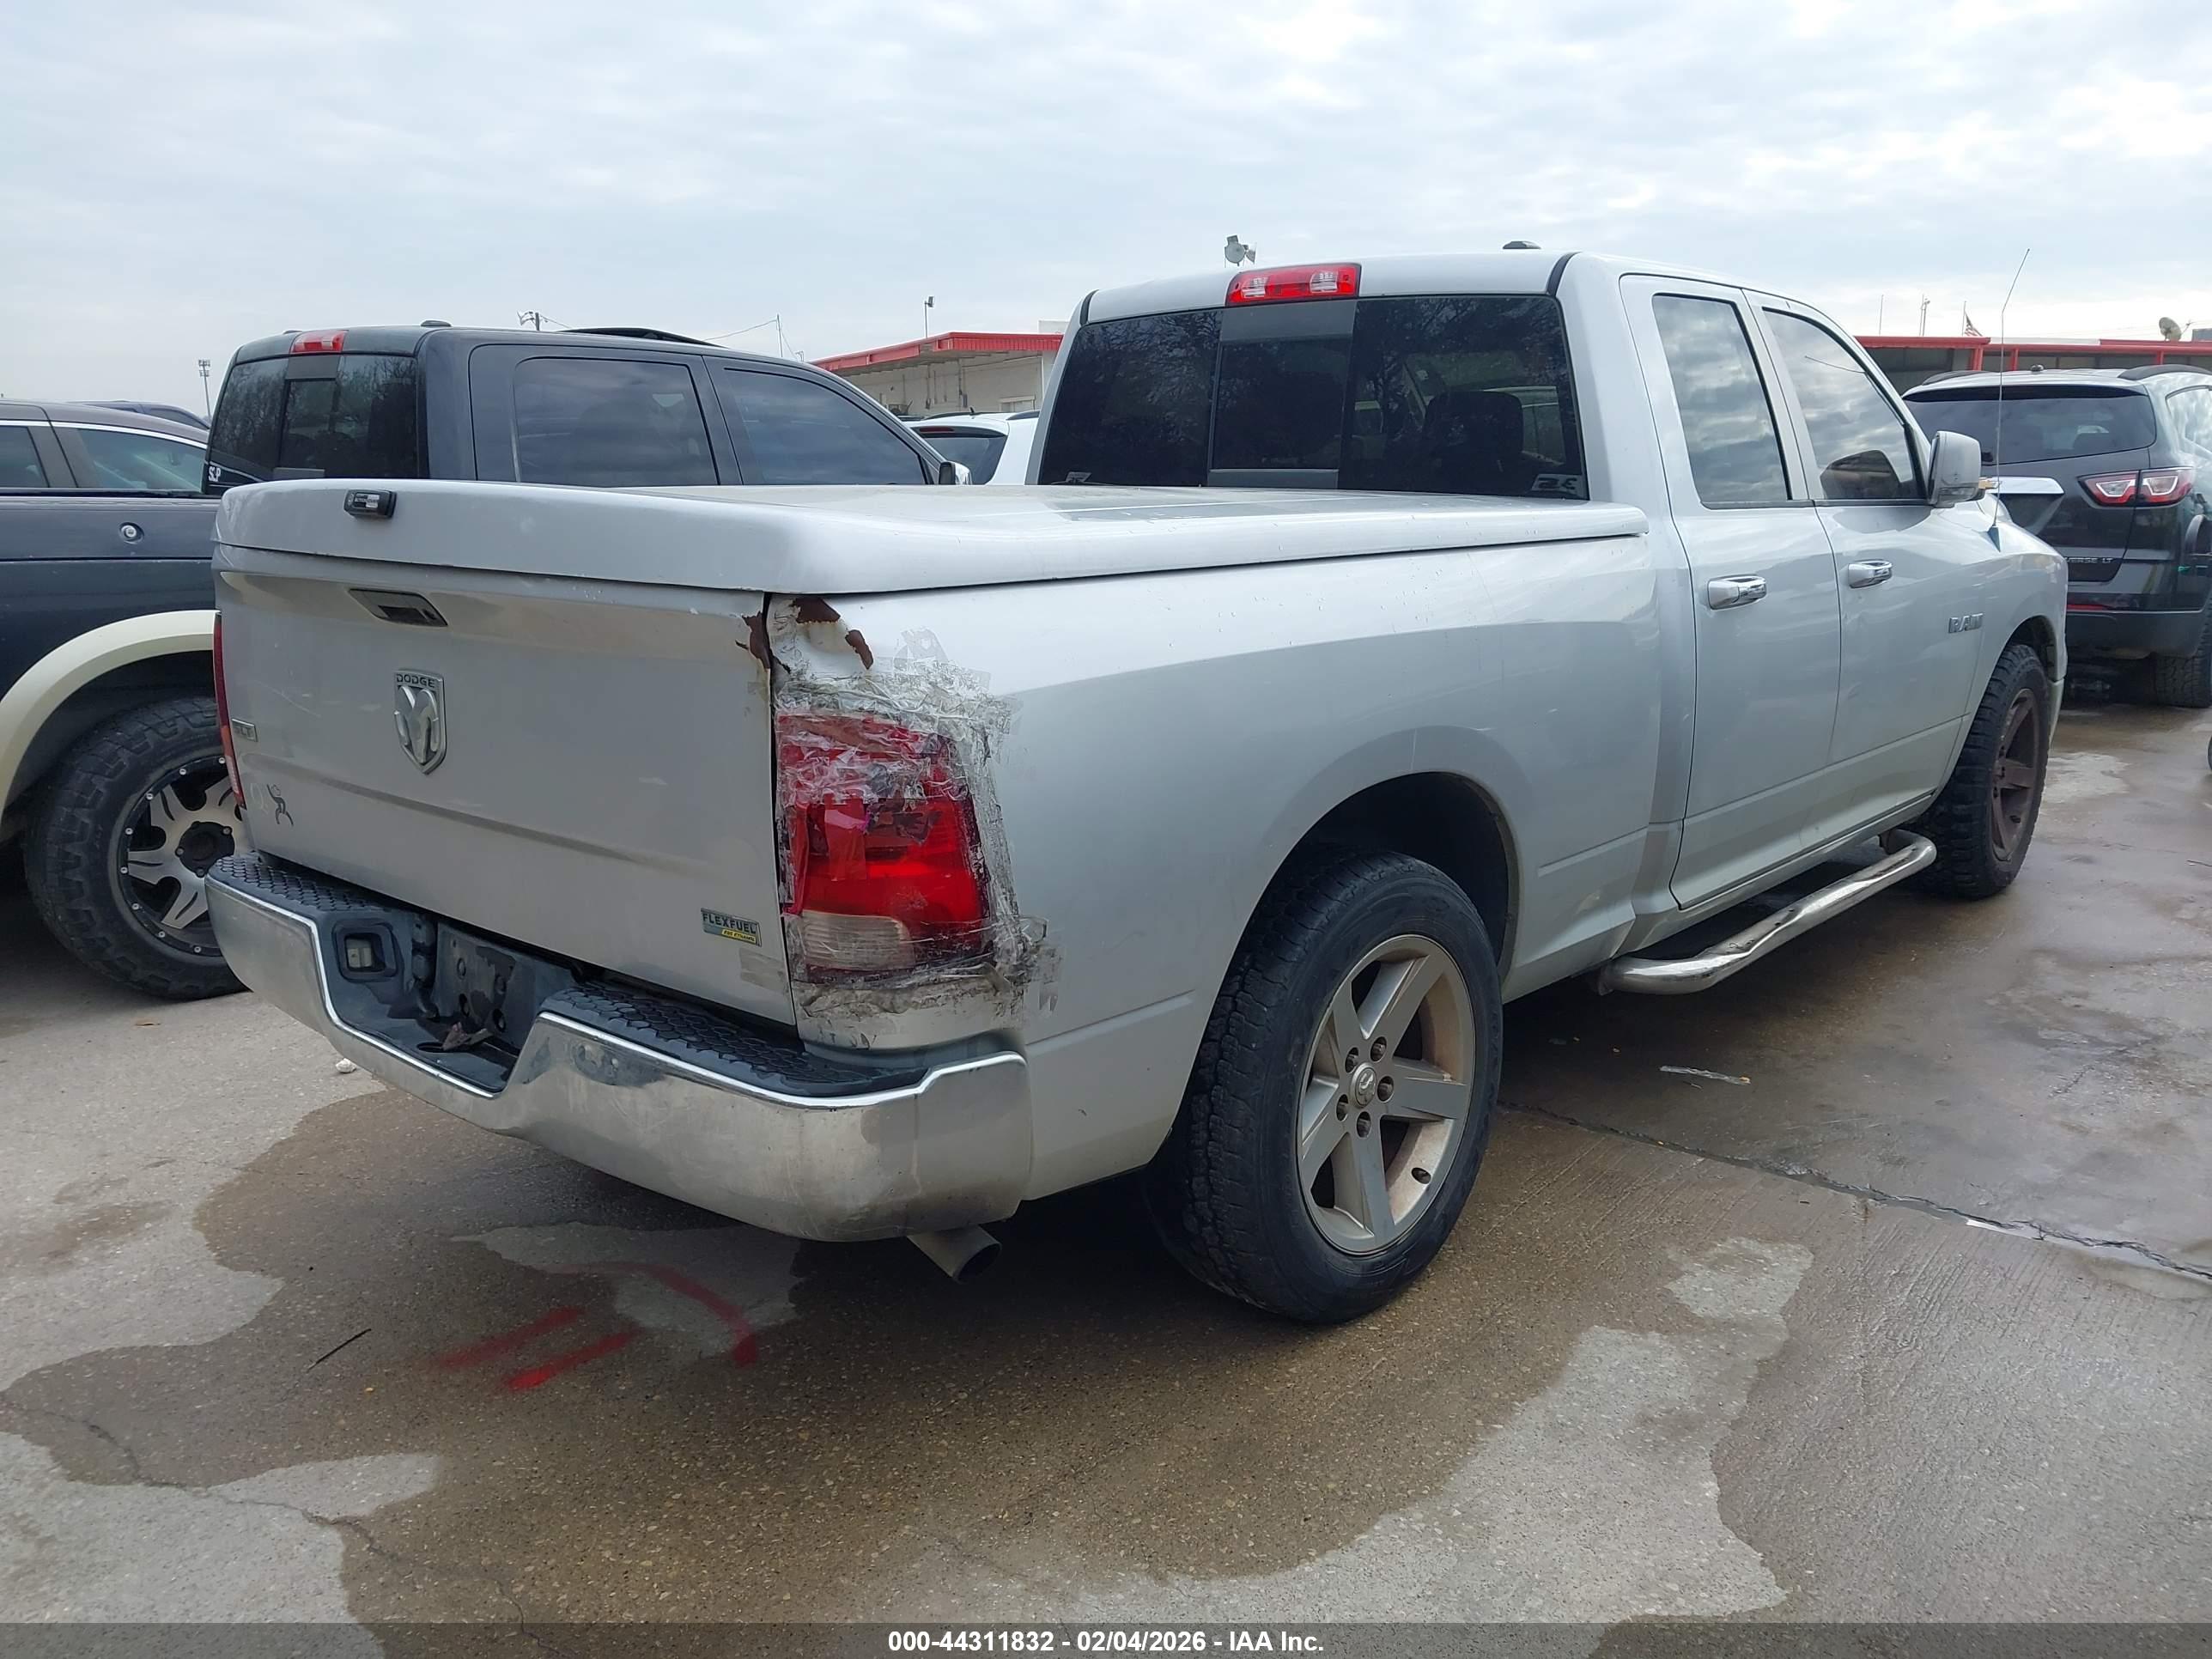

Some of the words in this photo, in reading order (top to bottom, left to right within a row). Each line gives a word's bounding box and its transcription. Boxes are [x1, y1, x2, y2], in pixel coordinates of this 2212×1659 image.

[1948, 613, 1984, 634] RAM
[396, 673, 435, 689] DODGE
[702, 912, 757, 935] FLEXFUEL
